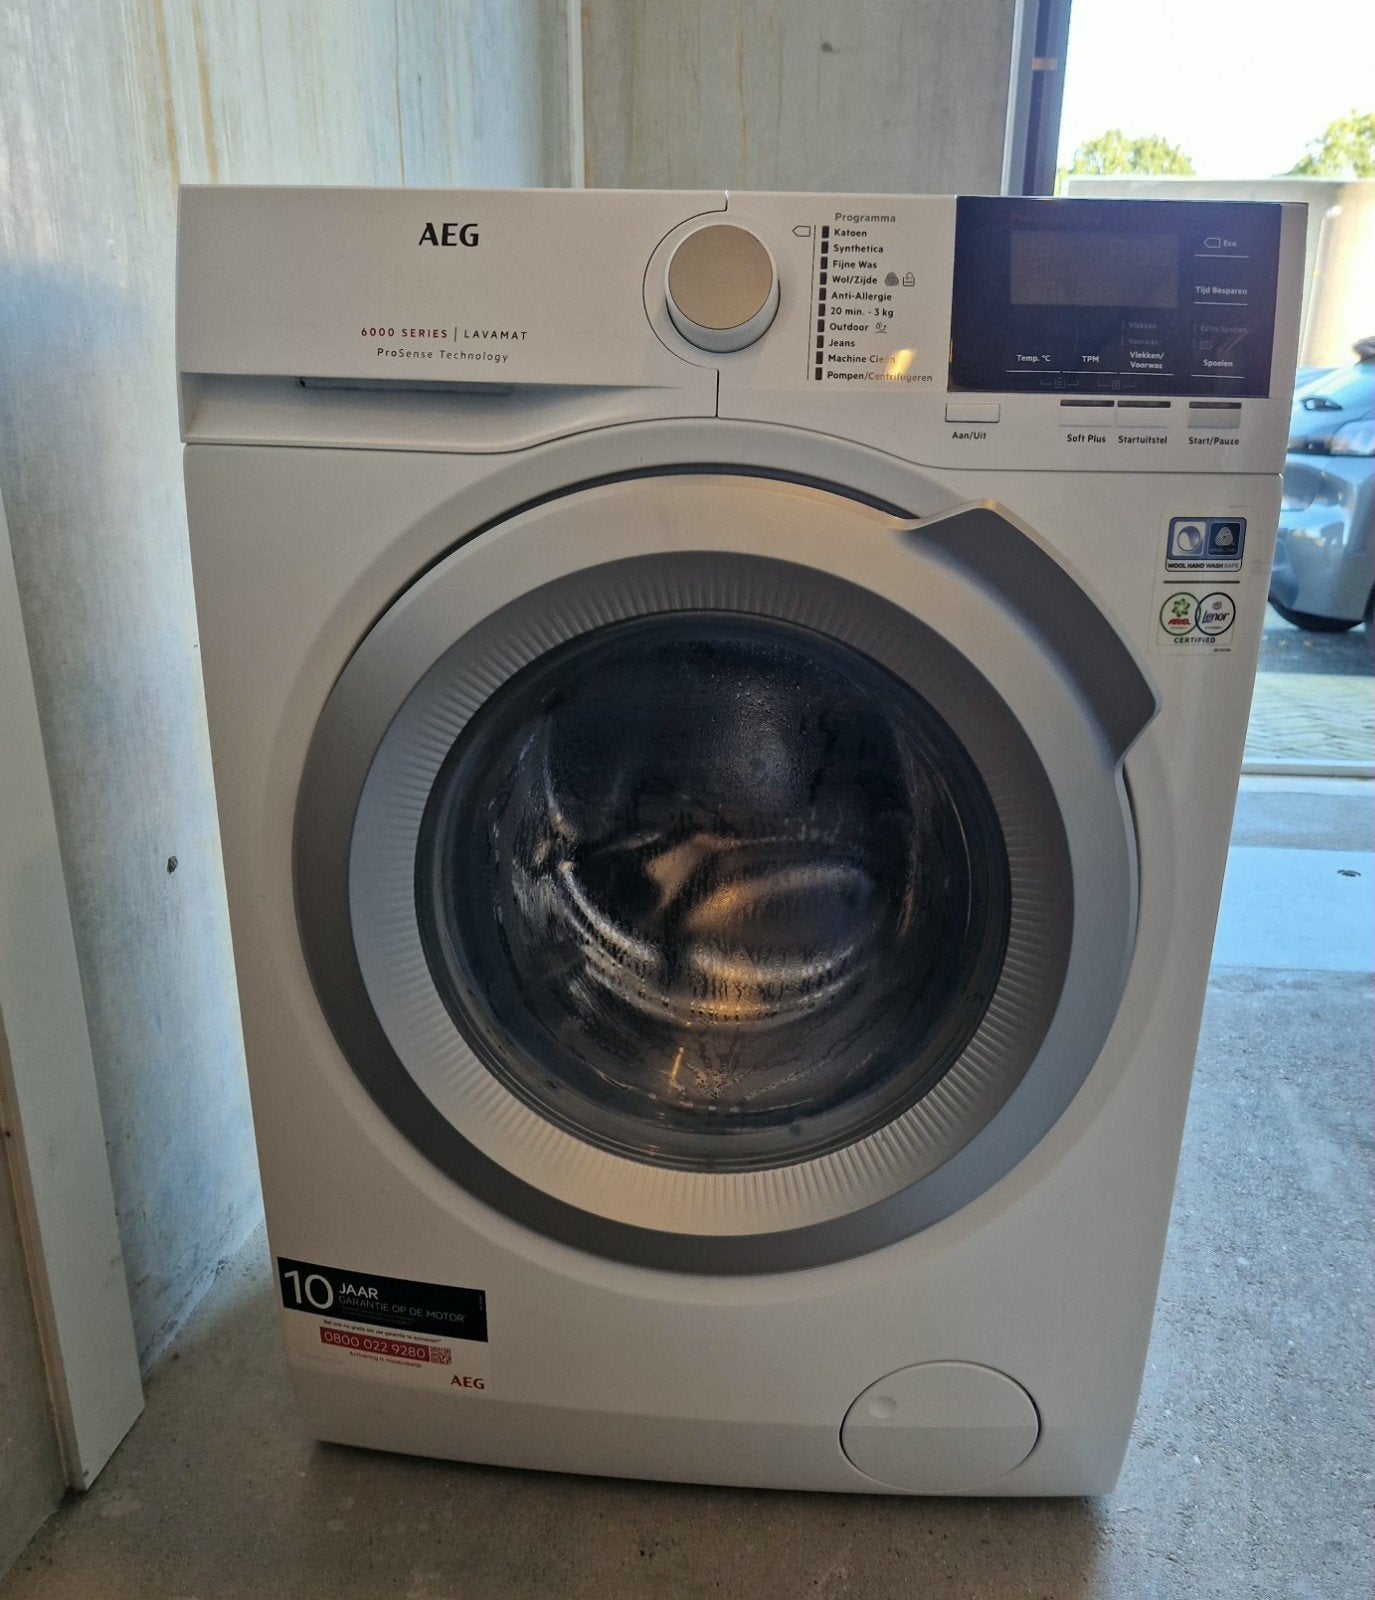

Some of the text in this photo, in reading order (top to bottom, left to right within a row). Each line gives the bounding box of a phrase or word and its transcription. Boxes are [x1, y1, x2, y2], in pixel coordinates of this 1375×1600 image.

[834, 212, 896, 224] Programma
[418, 222, 480, 247] AEG
[834, 229, 867, 238] Katoen
[1223, 239, 1237, 247] Eco
[832, 244, 884, 254] Synthetica
[832, 260, 877, 270] Fijne Was
[831, 275, 878, 286] Wol/Zijde
[1195, 286, 1247, 296] Tijd Besparen
[831, 291, 892, 303] Anti-Allergie
[830, 306, 842, 315] 20
[844, 307, 865, 316] min.
[874, 308, 880, 316] 3
[882, 308, 894, 319] kg
[829, 323, 869, 331] Outdoor
[361, 327, 528, 341] 6000 SERIES LAVAMAT
[828, 339, 855, 347] Jeans
[377, 347, 508, 364] ProSense Technology
[828, 354, 867, 363] Machine
[1016, 354, 1051, 364] Temp. °C
[1082, 355, 1100, 363] TPM
[1129, 351, 1164, 360] Vlekken/
[1130, 361, 1163, 369] Voorwas
[1203, 359, 1233, 368] Spoelen
[827, 371, 933, 383] Pompen/Centrifugeren
[952, 431, 987, 440] Aan/Uit
[1066, 433, 1106, 444] Soft Plus
[1118, 434, 1167, 445] Startuitstel
[1188, 435, 1240, 446] Start/Pauze
[1202, 610, 1230, 624] Lenor
[284, 1270, 379, 1310] 10 JAAR
[338, 1295, 390, 1313] GARANTIE
[392, 1304, 406, 1314] OP
[409, 1307, 423, 1318] DE
[324, 1331, 426, 1359] 0800 022 9280
[450, 1375, 485, 1390] AEG
